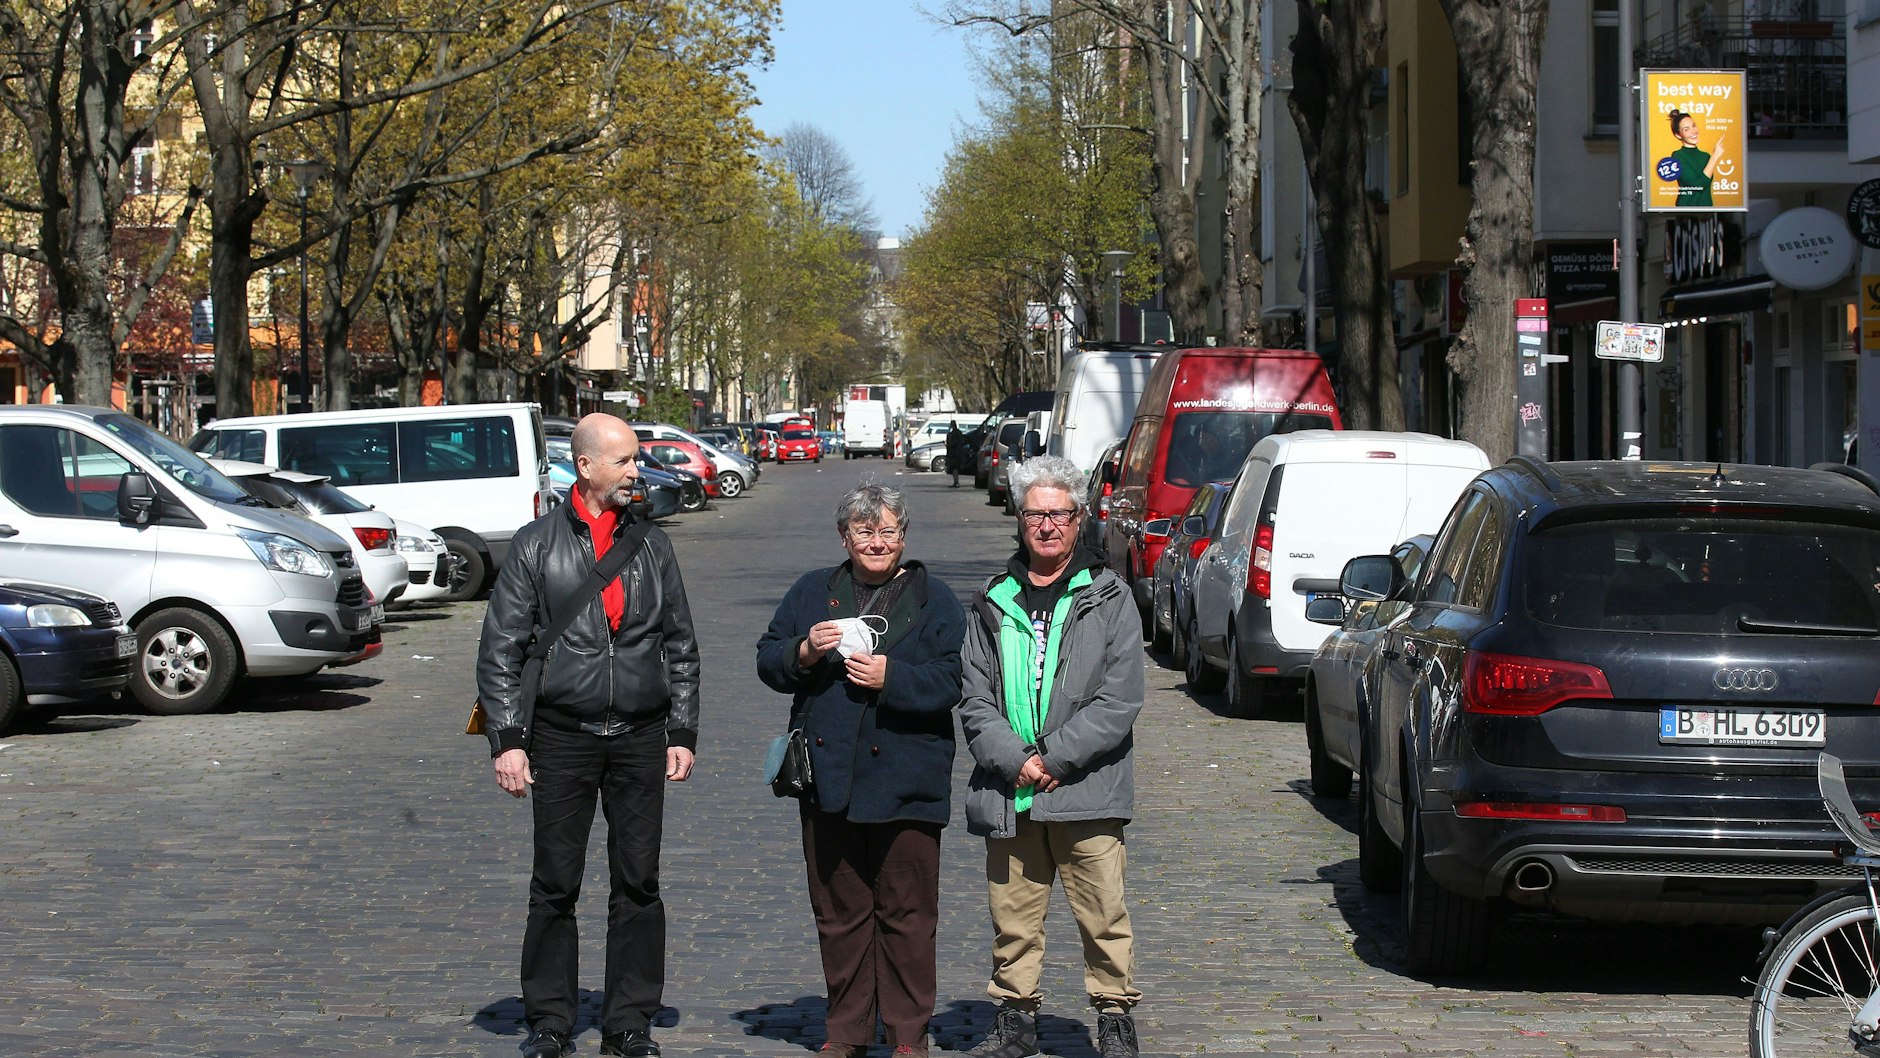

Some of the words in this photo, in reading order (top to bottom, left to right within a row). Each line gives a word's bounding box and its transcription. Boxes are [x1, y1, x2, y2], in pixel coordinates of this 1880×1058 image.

[1658, 82, 1694, 97] best
[1698, 85, 1732, 99] way
[1658, 101, 1676, 114] to
[1680, 100, 1715, 116] stay
[1658, 165, 1671, 176] 12
[1670, 162, 1680, 172] €
[1712, 178, 1738, 191] a&o
[1858, 181, 1880, 197] SPÄT
[1777, 236, 1835, 252] BURGERS
[1551, 252, 1587, 263] GEMÜSE
[1796, 250, 1830, 260] BERLIN
[1553, 264, 1580, 273] PIZZA
[1173, 397, 1335, 413] www.landesjugendwerk-berlin.de
[1665, 724, 1672, 733] D
[1678, 709, 1694, 735] B
[1714, 710, 1748, 736] HL
[1755, 711, 1820, 738] 6309
